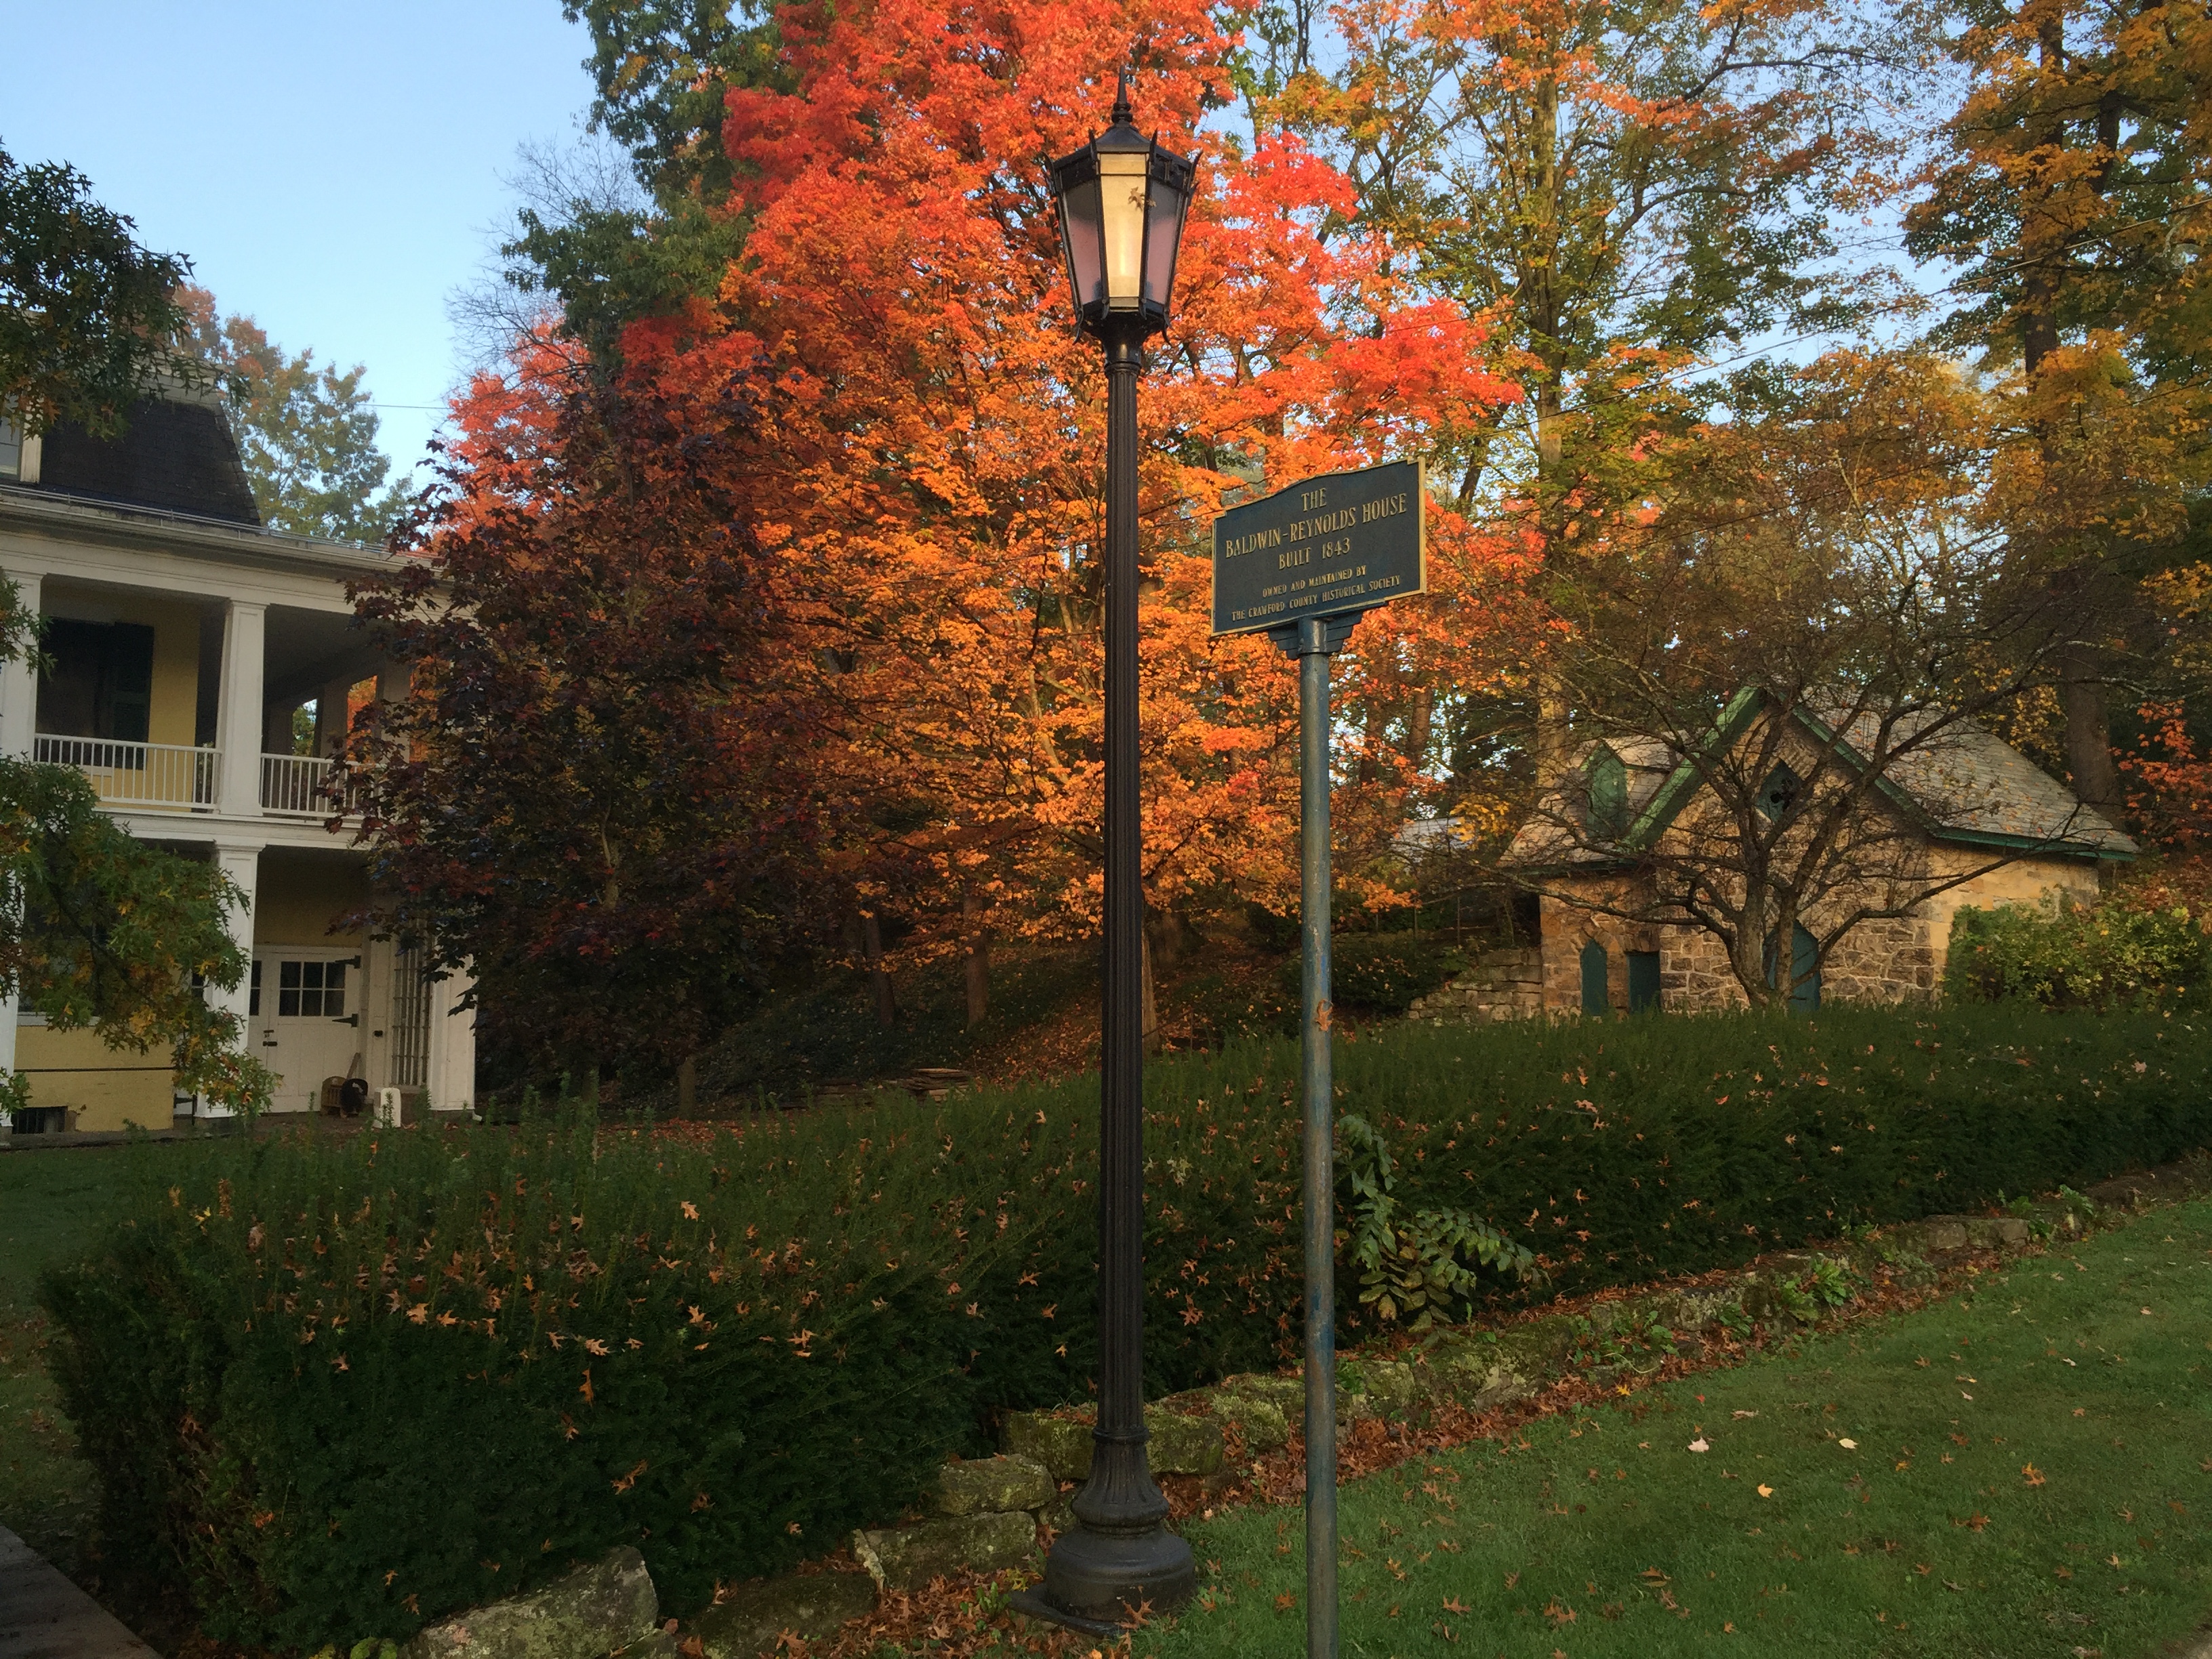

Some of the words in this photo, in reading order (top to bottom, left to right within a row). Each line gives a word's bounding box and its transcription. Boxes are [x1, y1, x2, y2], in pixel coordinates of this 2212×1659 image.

[1301, 487, 1327, 512] THE
[1362, 493, 1408, 524] HOUSE
[1279, 547, 1312, 570] BUILT
[1322, 537, 1351, 559] 1843
[1263, 583, 1287, 597] OWNED
[1290, 579, 1305, 592] AND
[1309, 568, 1353, 587] MAINTAINED
[1356, 565, 1367, 576] BY
[1231, 610, 1246, 621] THE
[1248, 602, 1285, 618] CRAWFORD
[1289, 594, 1317, 609] COUNTY
[1322, 583, 1366, 602] HISTORICAL
[1369, 575, 1401, 592] SOCIETY
